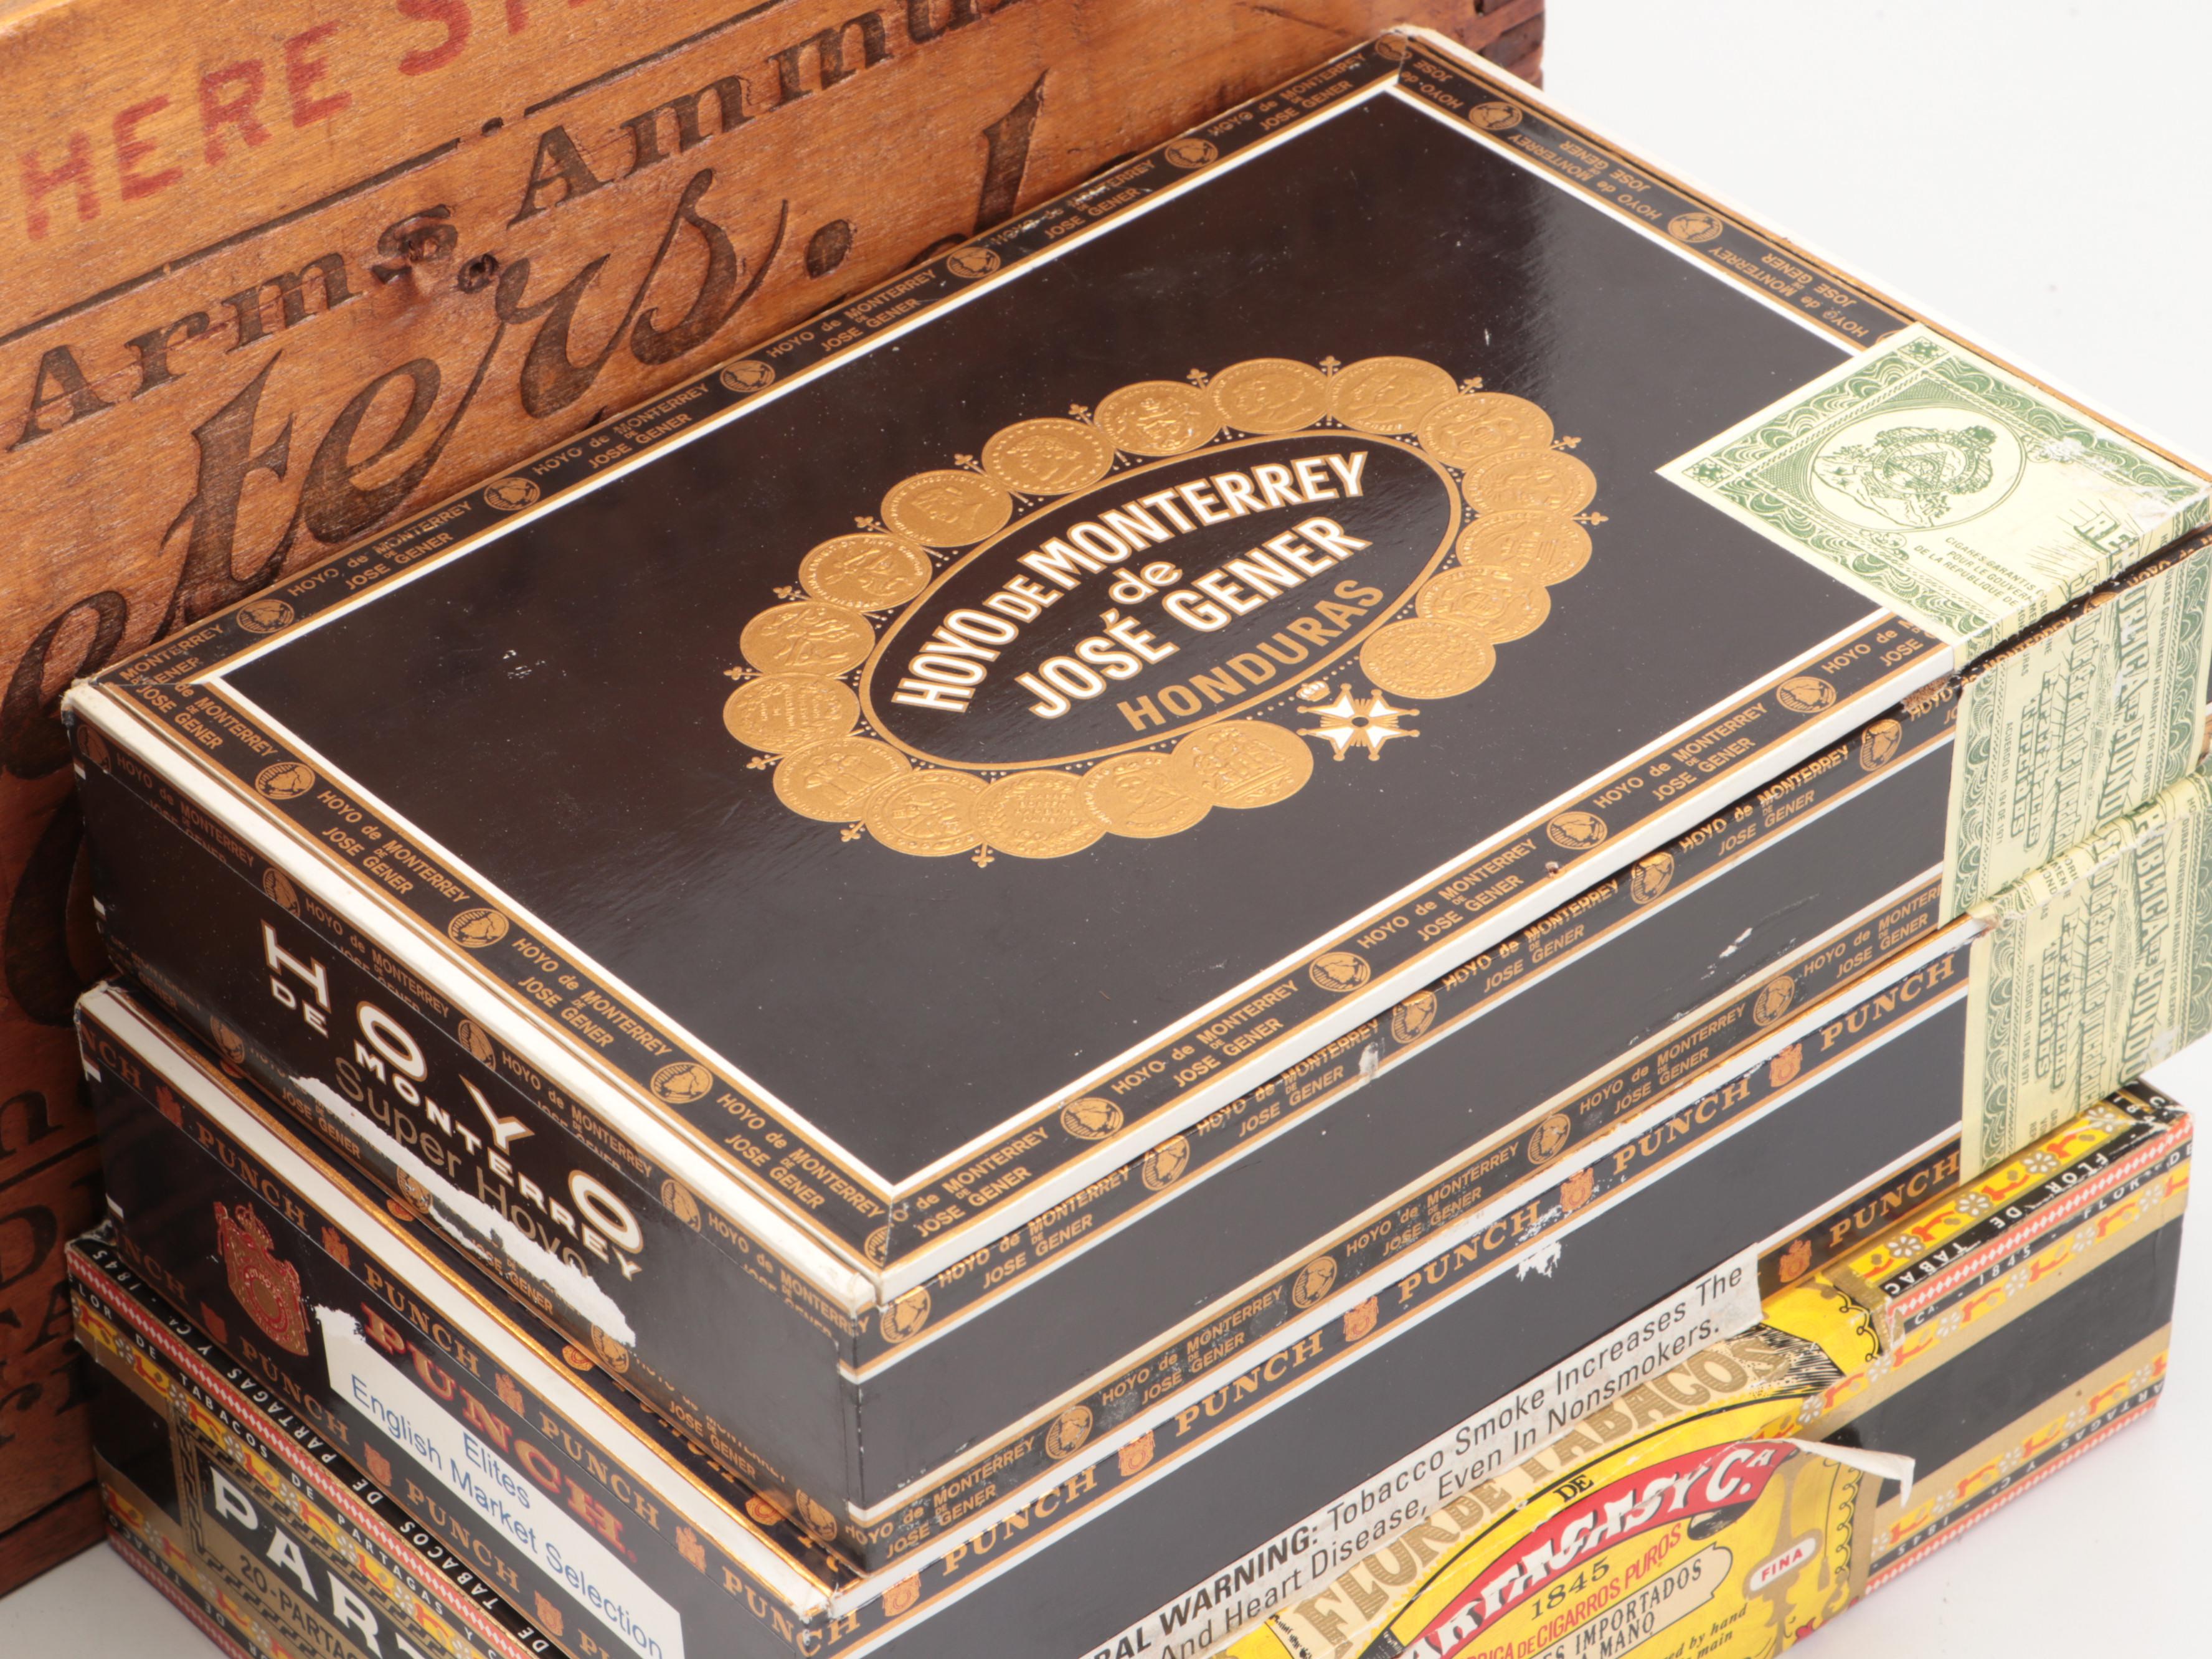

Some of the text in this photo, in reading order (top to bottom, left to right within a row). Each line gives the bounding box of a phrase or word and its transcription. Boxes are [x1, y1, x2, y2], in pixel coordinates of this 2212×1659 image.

[17, 19, 353, 241] HERE
[507, 0, 1021, 230] Ammu
[286, 502, 471, 596] HOYO de MONTERREY
[346, 532, 452, 589] JOSE GENER
[1017, 451, 1368, 590] MONTERREY
[1945, 537, 2036, 590] CIGARES GARANTIS
[1947, 551, 1971, 567] POUR
[983, 575, 1064, 623] DE
[1014, 516, 1373, 719] JOSÉ GENER
[1108, 561, 1183, 604] de
[1914, 545, 2019, 607] DE LA REPUBLIQUE DE
[891, 608, 1019, 713] HOYO
[1117, 579, 1384, 732] HONDURAS
[2002, 722, 2013, 767] ACUERDO
[318, 790, 469, 902] HOYO de MONTERREY
[322, 827, 413, 893] JOSE GENER
[1995, 823, 2004, 845] 1971
[1358, 839, 1535, 948] HOYO de MONTERREY
[1418, 874, 1523, 940] JOSE GENER
[1485, 924, 1584, 991] JOSE GENER
[1822, 955, 1954, 1049] PUNCH
[271, 975, 328, 1038] DE
[1111, 980, 1298, 1094] HOYO de MONTERREY
[1173, 1018, 1283, 1086] JOSE GENER
[1579, 1079, 1624, 1113] HOYO
[1657, 1004, 1745, 1071] MONTERREY
[1615, 1047, 1709, 1113] JOSE GENER
[336, 1057, 461, 1174] Super
[354, 1041, 643, 1282] MONTERREY
[717, 1092, 885, 1217] HOYO de MONTERREY
[1614, 1079, 1749, 1174] PUNCH
[197, 1122, 306, 1230] PUNCH
[725, 1135, 825, 1208] JOSE GENER
[1828, 1151, 1959, 1247] PUNCH
[92, 1250, 141, 1290] 1845
[937, 1247, 990, 1286] HOYO
[1026, 1165, 1129, 1239] MONTERREY
[983, 1214, 1092, 1288] JOSE GENER
[1397, 1201, 1541, 1302] PUNCH
[1978, 1244, 2032, 1285] 1845
[366, 1264, 478, 1375] PUNCH
[227, 1367, 338, 1463] PARTAGAS
[361, 1303, 625, 1556] PUNCH
[1176, 1330, 1323, 1435] PUNCH
[2061, 1381, 2165, 1451] ARTAGAS
[136, 1334, 158, 1360] DE
[179, 1372, 269, 1458] TABACOS
[291, 1473, 316, 1501] DE
[338, 1513, 443, 1615] PARTAGAS
[352, 1478, 384, 1504] DE
[463, 1432, 531, 1508] Elites
[541, 1413, 658, 1528] PUNCH
[1159, 1524, 1318, 1636] WARNING:
[1327, 1449, 1444, 1532] Tobacco
[1455, 1389, 1545, 1456] Smoke
[1557, 1298, 1686, 1396] Increases
[1696, 1265, 1742, 1306] The
[1162, 1622, 1212, 1659] And
[1225, 1569, 1302, 1634] Heart
[1312, 1498, 1429, 1580] Disease,
[1439, 1446, 1502, 1500] Even
[1513, 1427, 1536, 1456] In
[1548, 1321, 1721, 1439] Nonsmokers.
[1553, 1474, 1595, 1503] DE
[209, 1465, 426, 1659] PAR
[352, 1374, 663, 1659] English Market Selection
[406, 1478, 518, 1591] PUNCH
[943, 1465, 1096, 1575] PUNCH
[1406, 1467, 1680, 1659] ARTAGAS
[399, 1521, 499, 1610] TABACOS
[1518, 1523, 1681, 1658] DE CIGARROS PUROS
[1531, 1556, 1611, 1622] 1845
[1575, 1559, 1703, 1654] IMPORTADOS
[1761, 1548, 1803, 1582] FINA
[518, 1627, 549, 1653] DE
[1688, 1602, 1747, 1653] by hand
